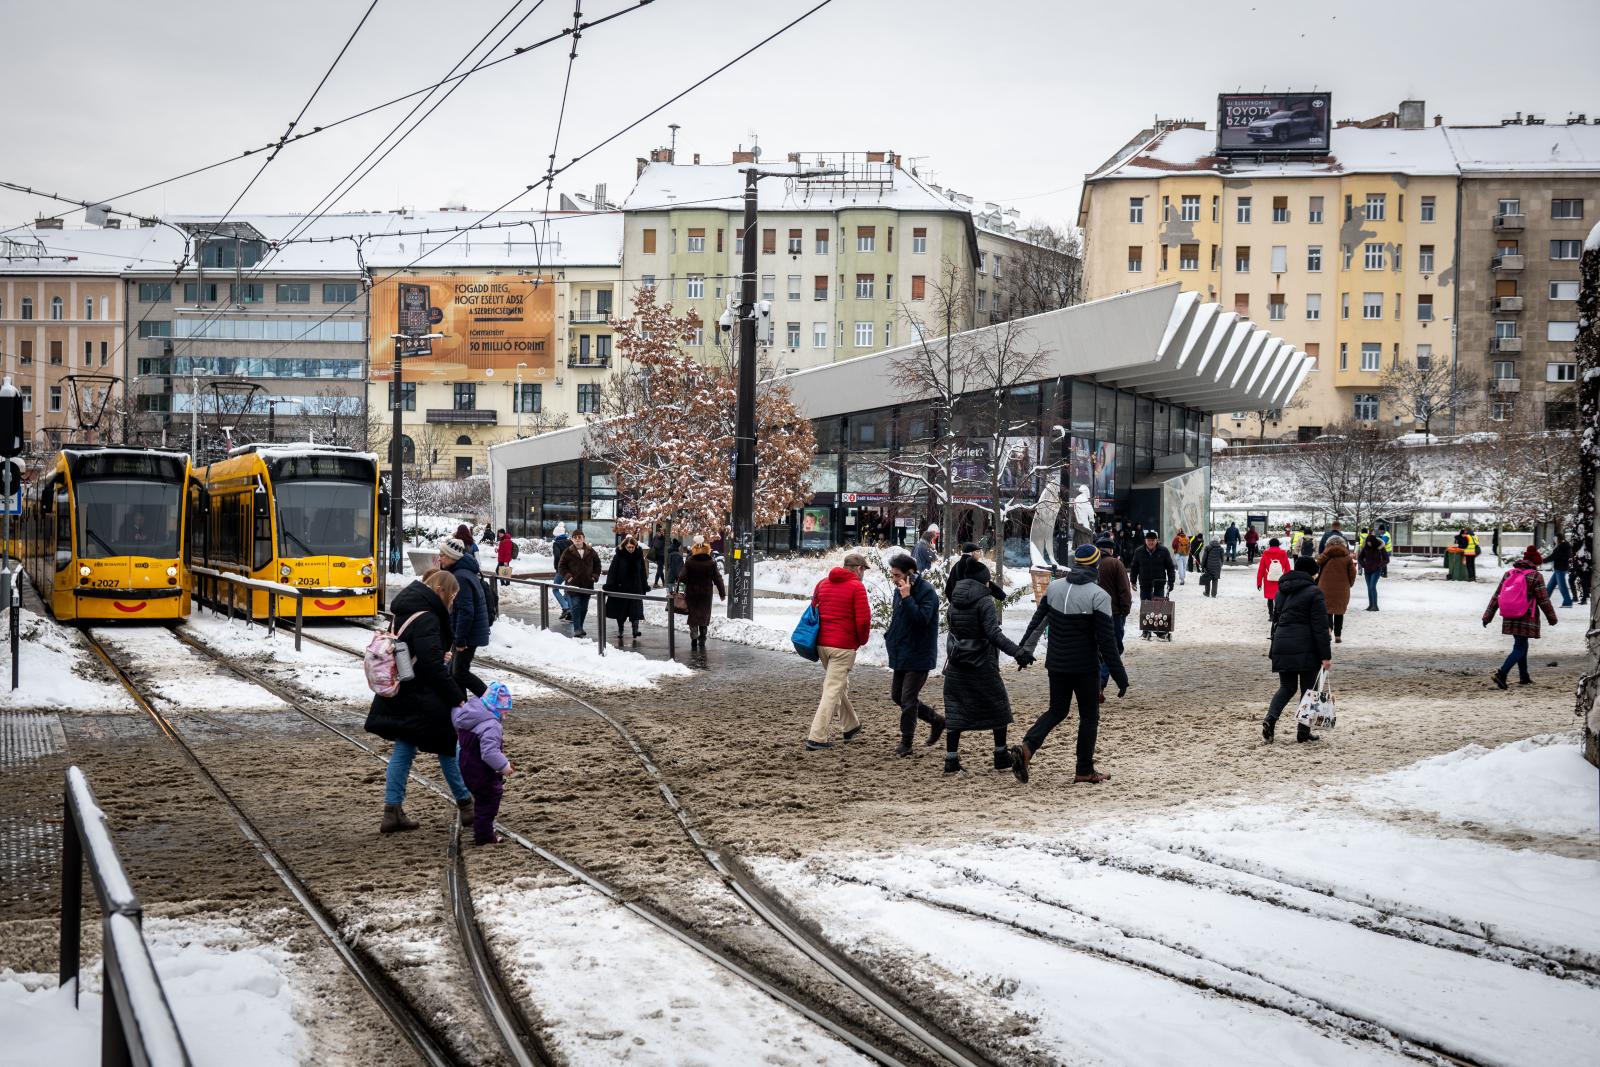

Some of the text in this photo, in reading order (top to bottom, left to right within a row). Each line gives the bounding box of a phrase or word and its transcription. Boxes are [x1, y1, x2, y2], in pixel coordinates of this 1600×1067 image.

[1226, 106, 1271, 116] TOYOTA
[1226, 116, 1255, 126] bZ4X
[455, 284, 489, 294] FOGADD
[455, 293, 524, 305] HOGY ESÉLYT ADSZ
[470, 339, 545, 351] 50 MILLIÓ FORINT
[97, 579, 119, 587] 2027
[298, 577, 320, 585] 2034
